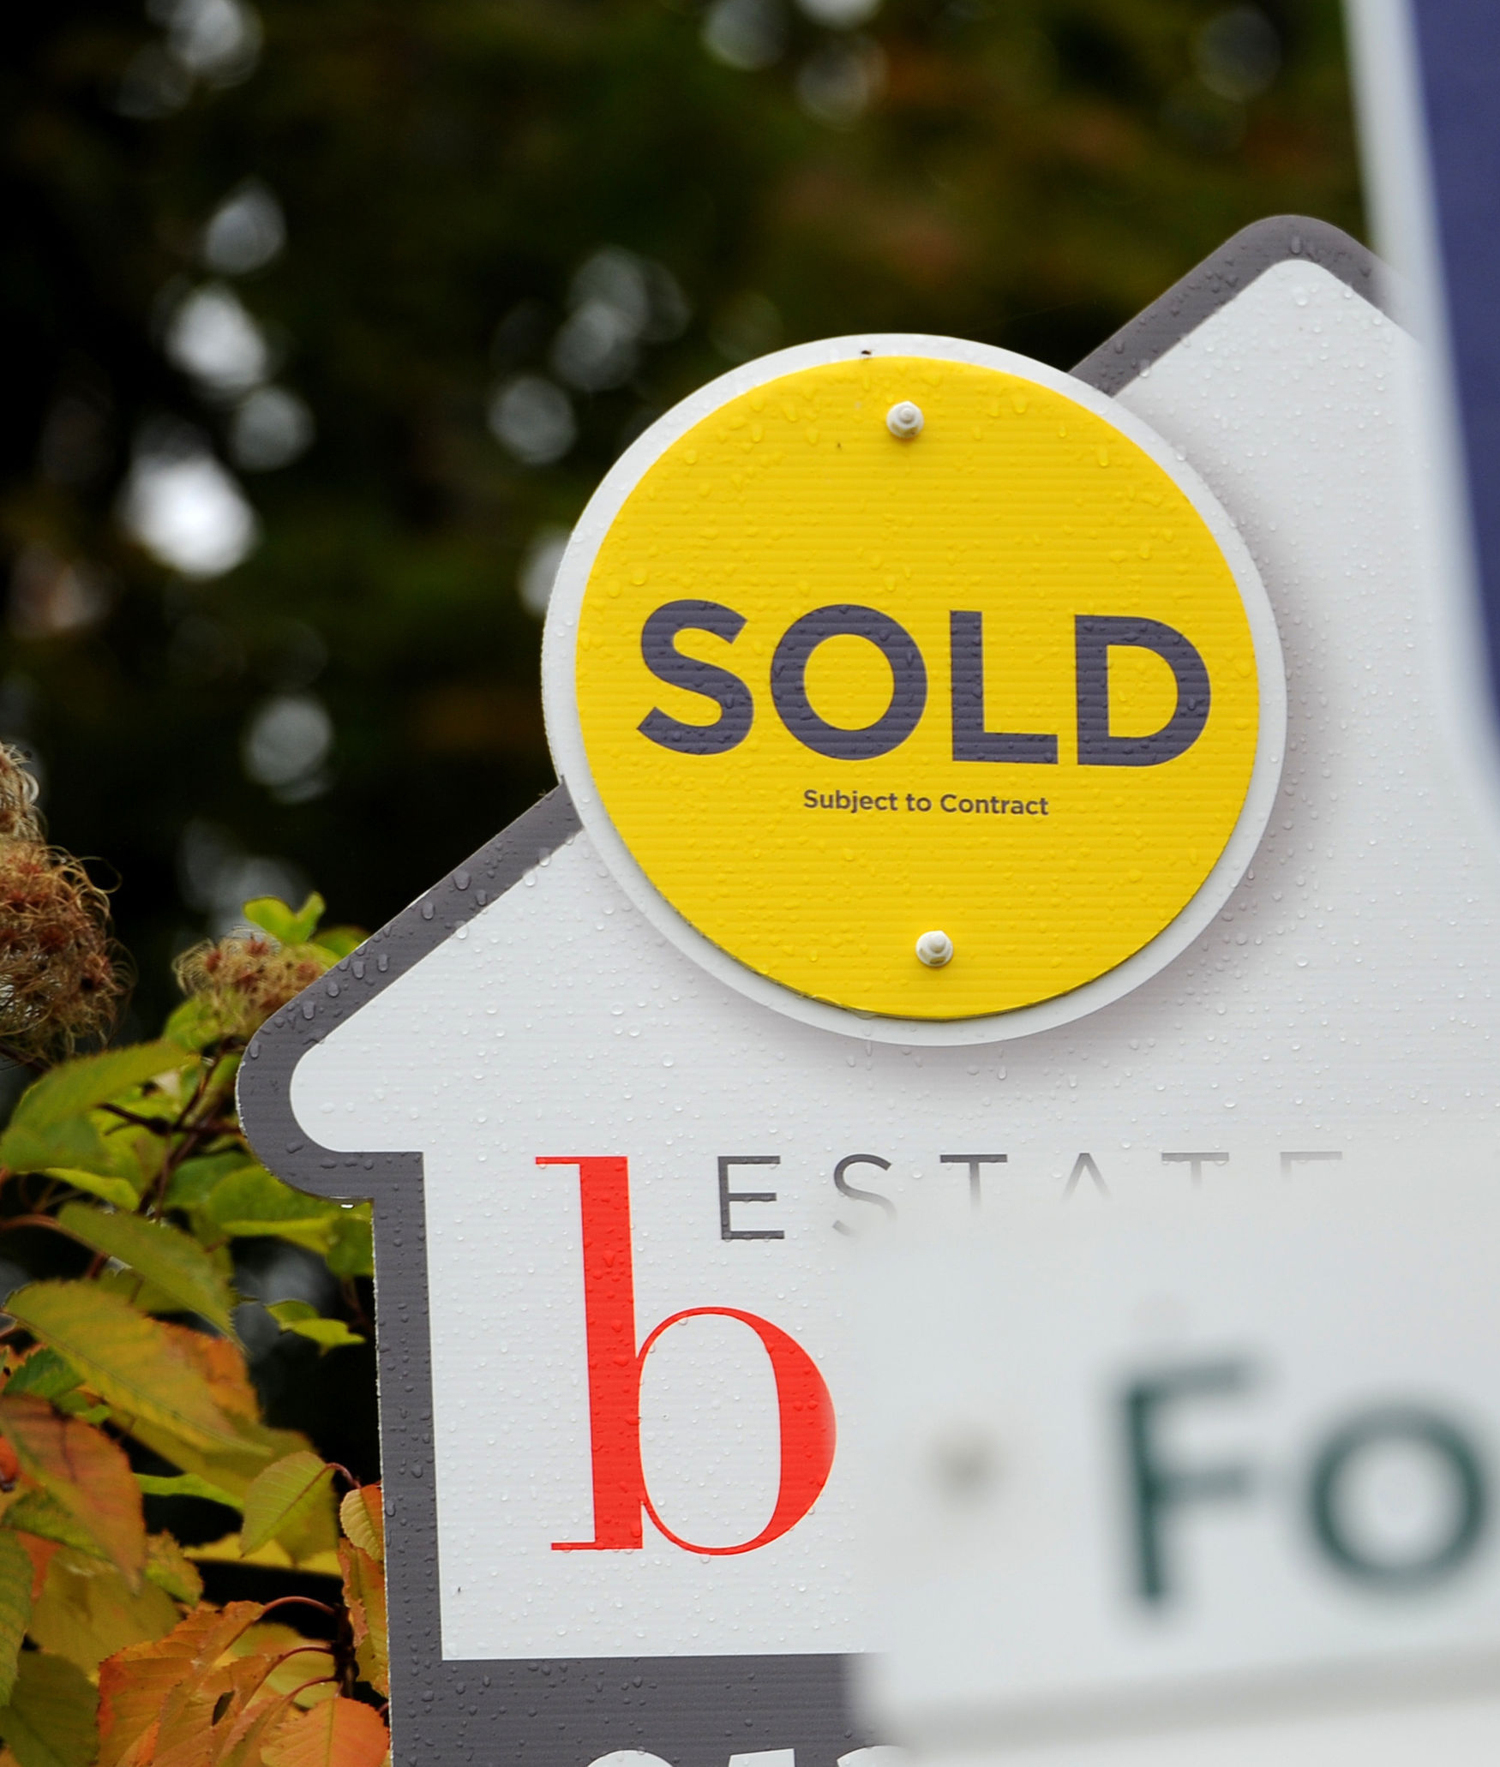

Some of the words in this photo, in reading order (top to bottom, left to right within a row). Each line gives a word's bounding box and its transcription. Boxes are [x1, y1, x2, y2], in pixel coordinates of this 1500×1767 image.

[636, 599, 1211, 767] SOLD
[803, 789, 898, 813] Subject
[906, 793, 932, 812] to
[940, 793, 1049, 816] Contract
[535, 1155, 837, 1556] b
